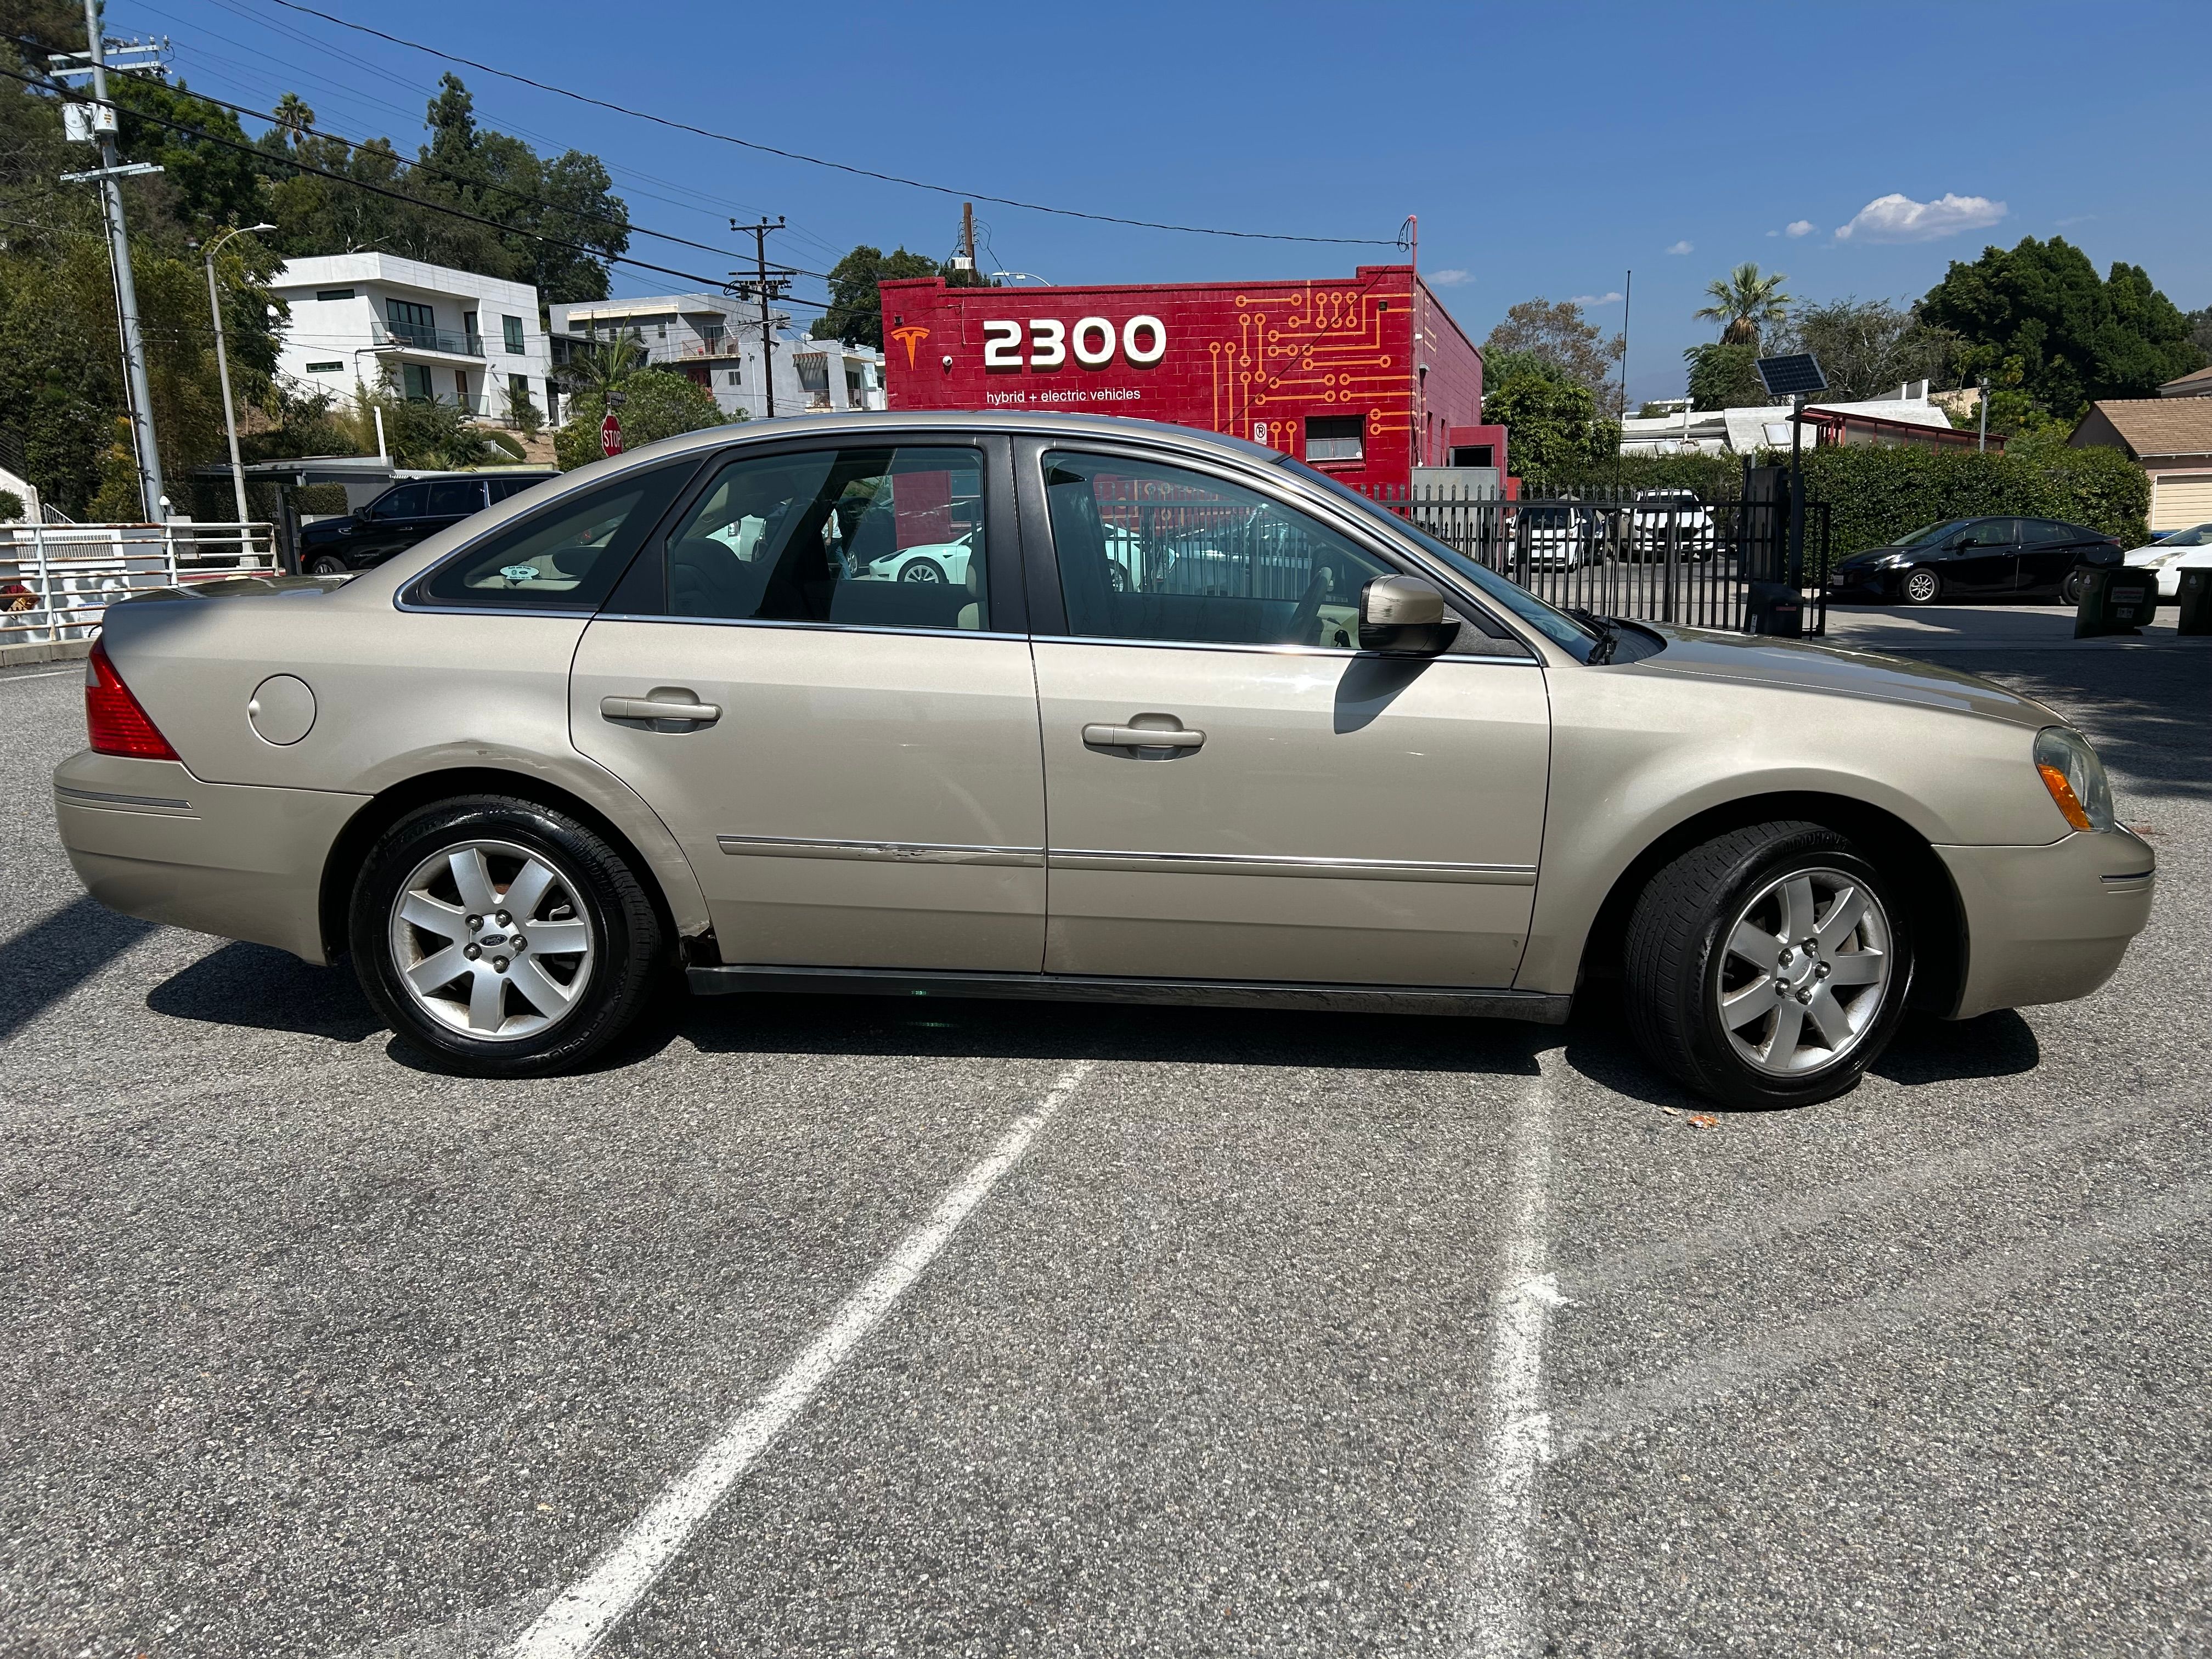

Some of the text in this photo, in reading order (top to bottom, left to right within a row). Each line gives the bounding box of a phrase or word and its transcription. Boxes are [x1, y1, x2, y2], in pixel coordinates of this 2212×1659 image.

[983, 314, 1167, 368] 2300
[987, 388, 1141, 405] hybrid + electric vehicles
[603, 430, 621, 448] STOP
